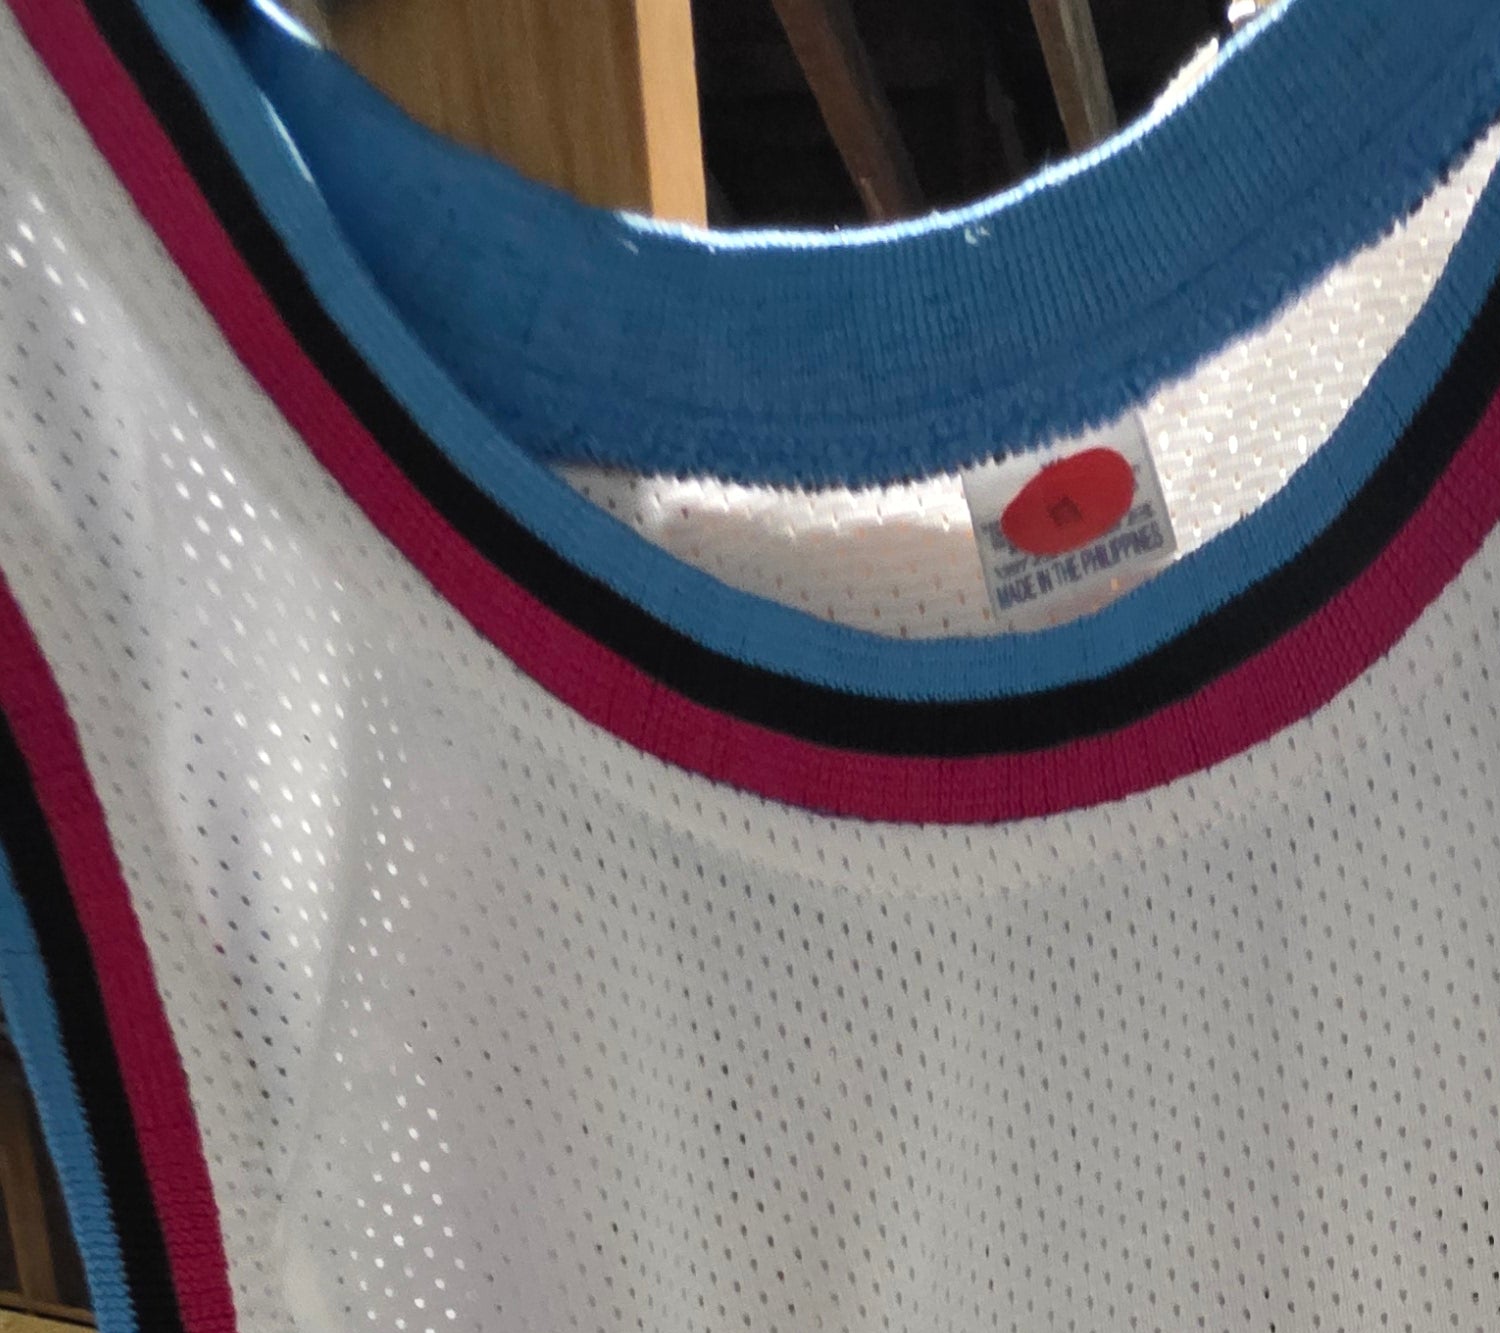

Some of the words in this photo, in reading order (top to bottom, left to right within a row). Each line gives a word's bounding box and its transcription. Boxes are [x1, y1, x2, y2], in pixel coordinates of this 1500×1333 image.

[996, 574, 1038, 610] MADE
[1035, 567, 1054, 595] IN
[1052, 555, 1083, 587] THE
[1079, 520, 1165, 575] PHILIPPINES
